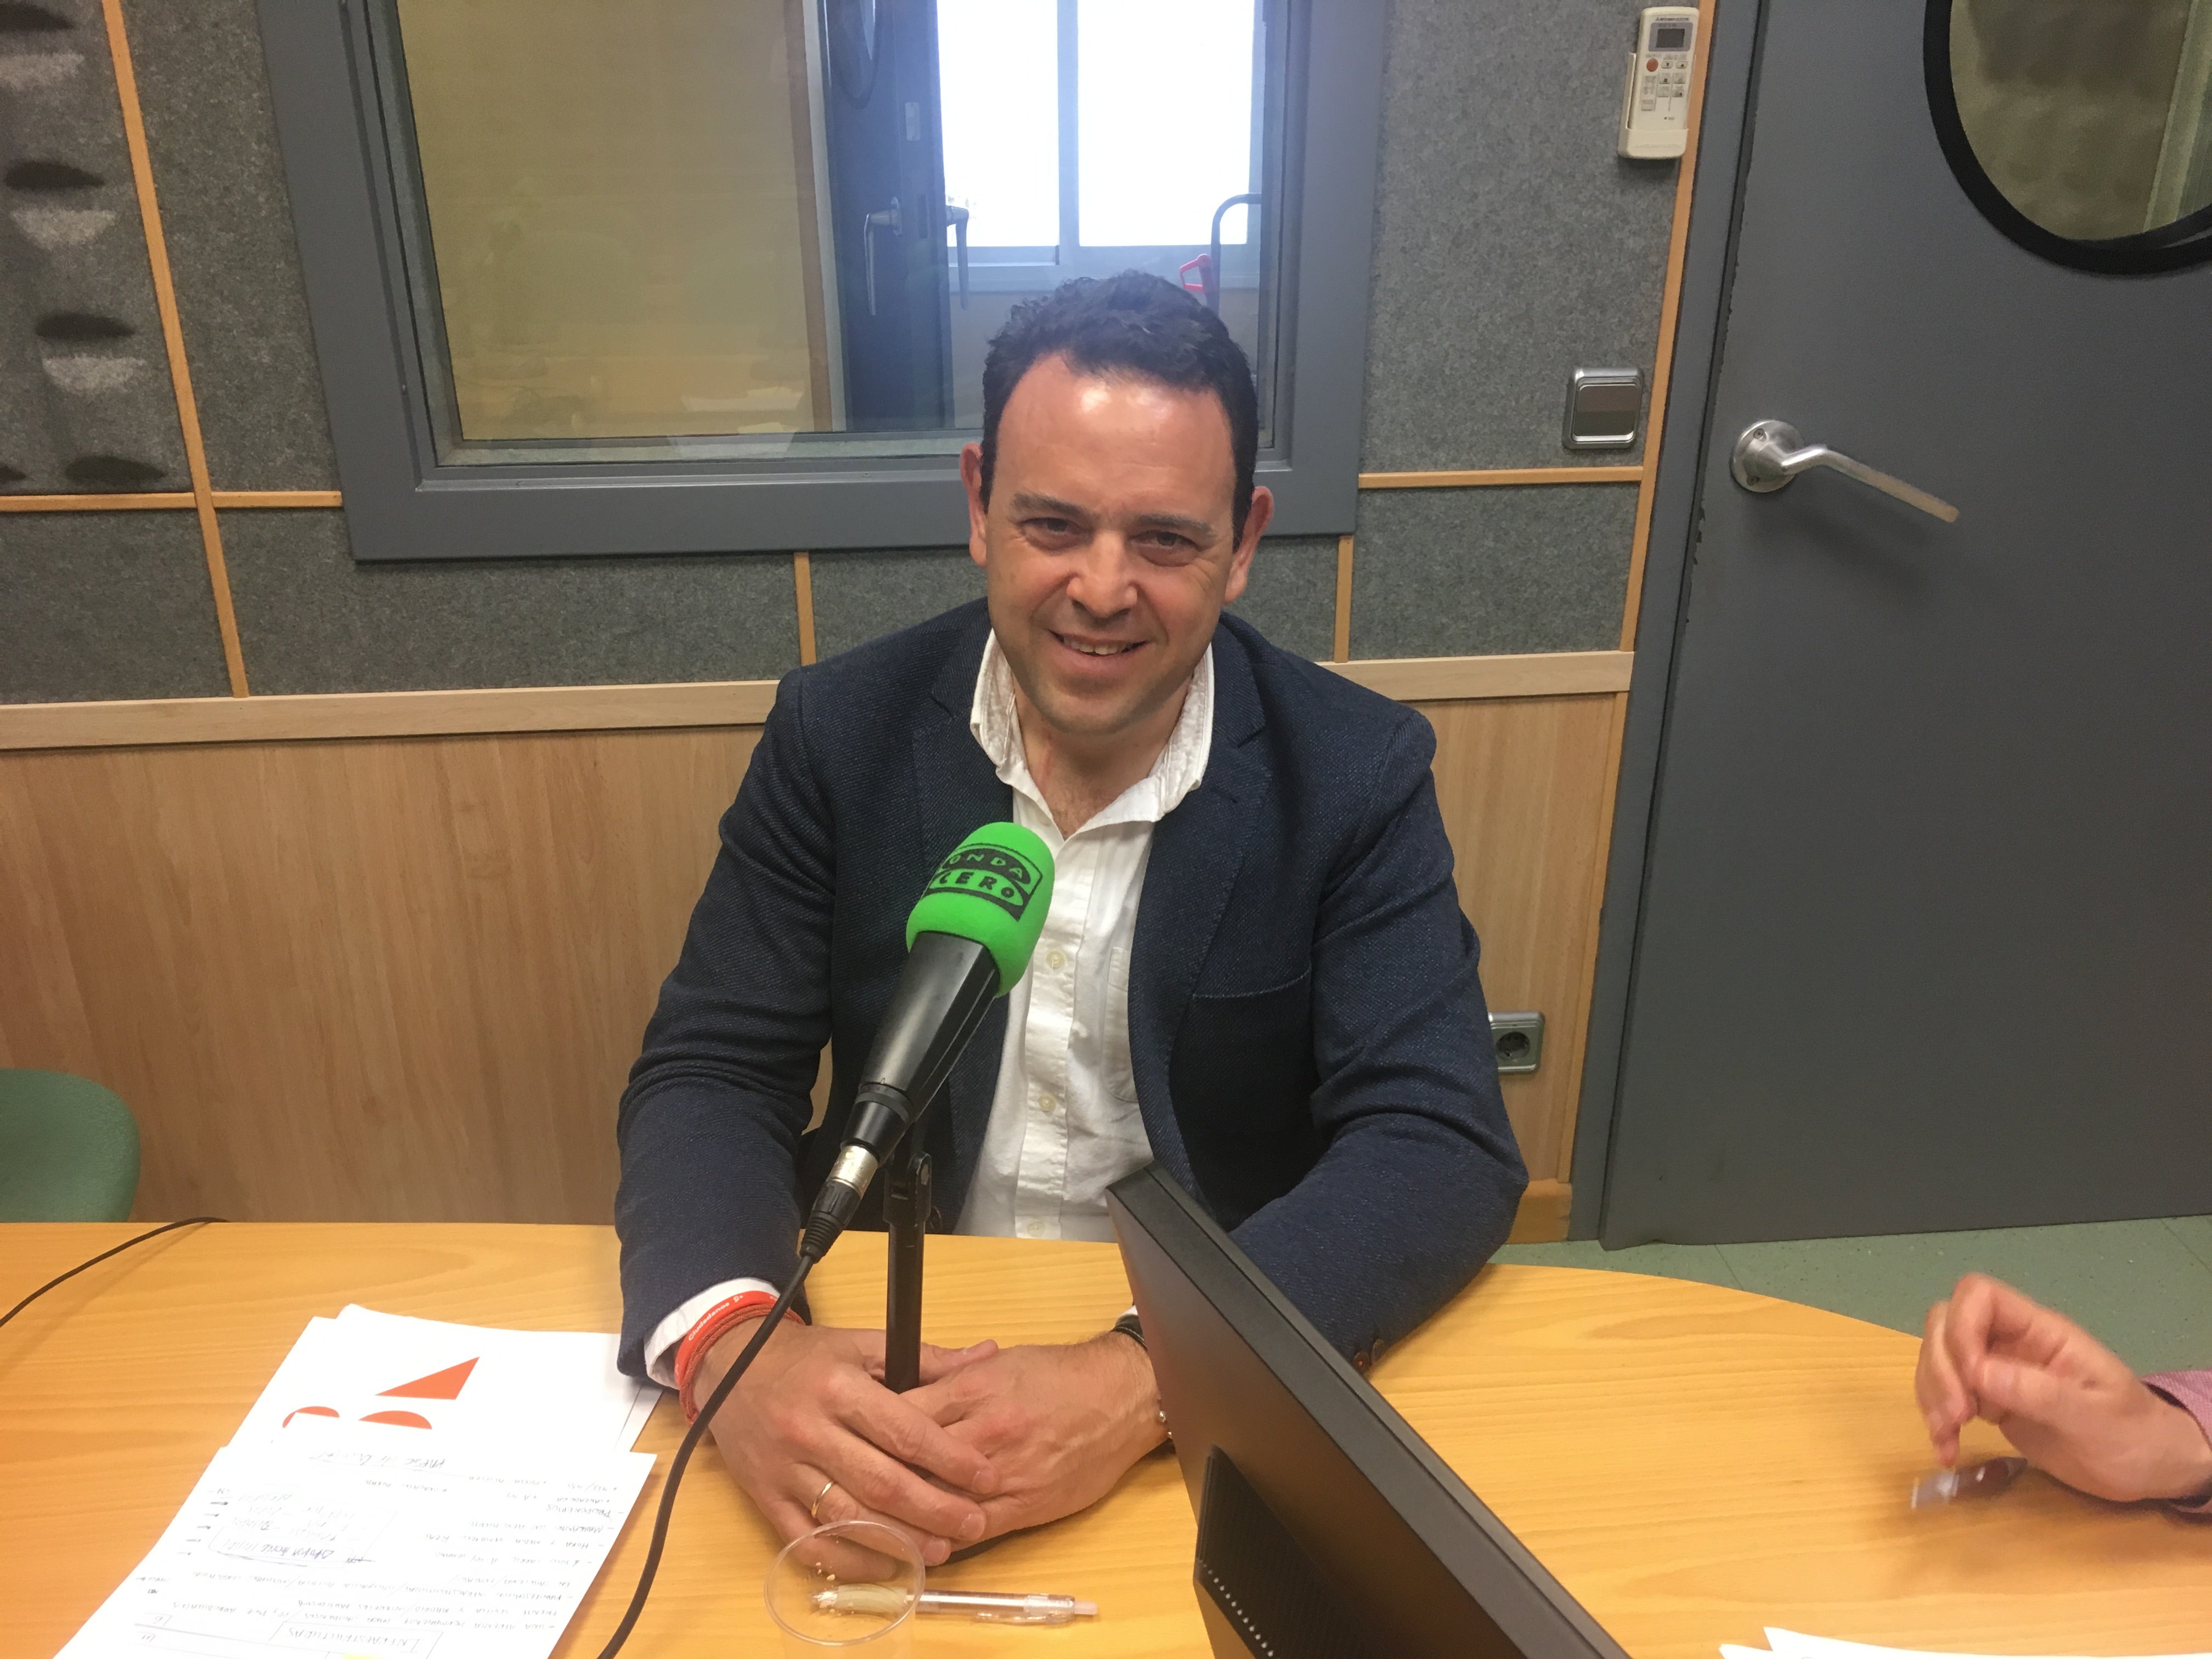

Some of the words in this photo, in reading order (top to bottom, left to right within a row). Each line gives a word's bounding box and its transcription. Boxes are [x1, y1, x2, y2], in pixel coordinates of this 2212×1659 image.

[949, 853, 1024, 880] ONDA
[938, 871, 1015, 899] CERO
[688, 1301, 730, 1341] Ciudadanos
